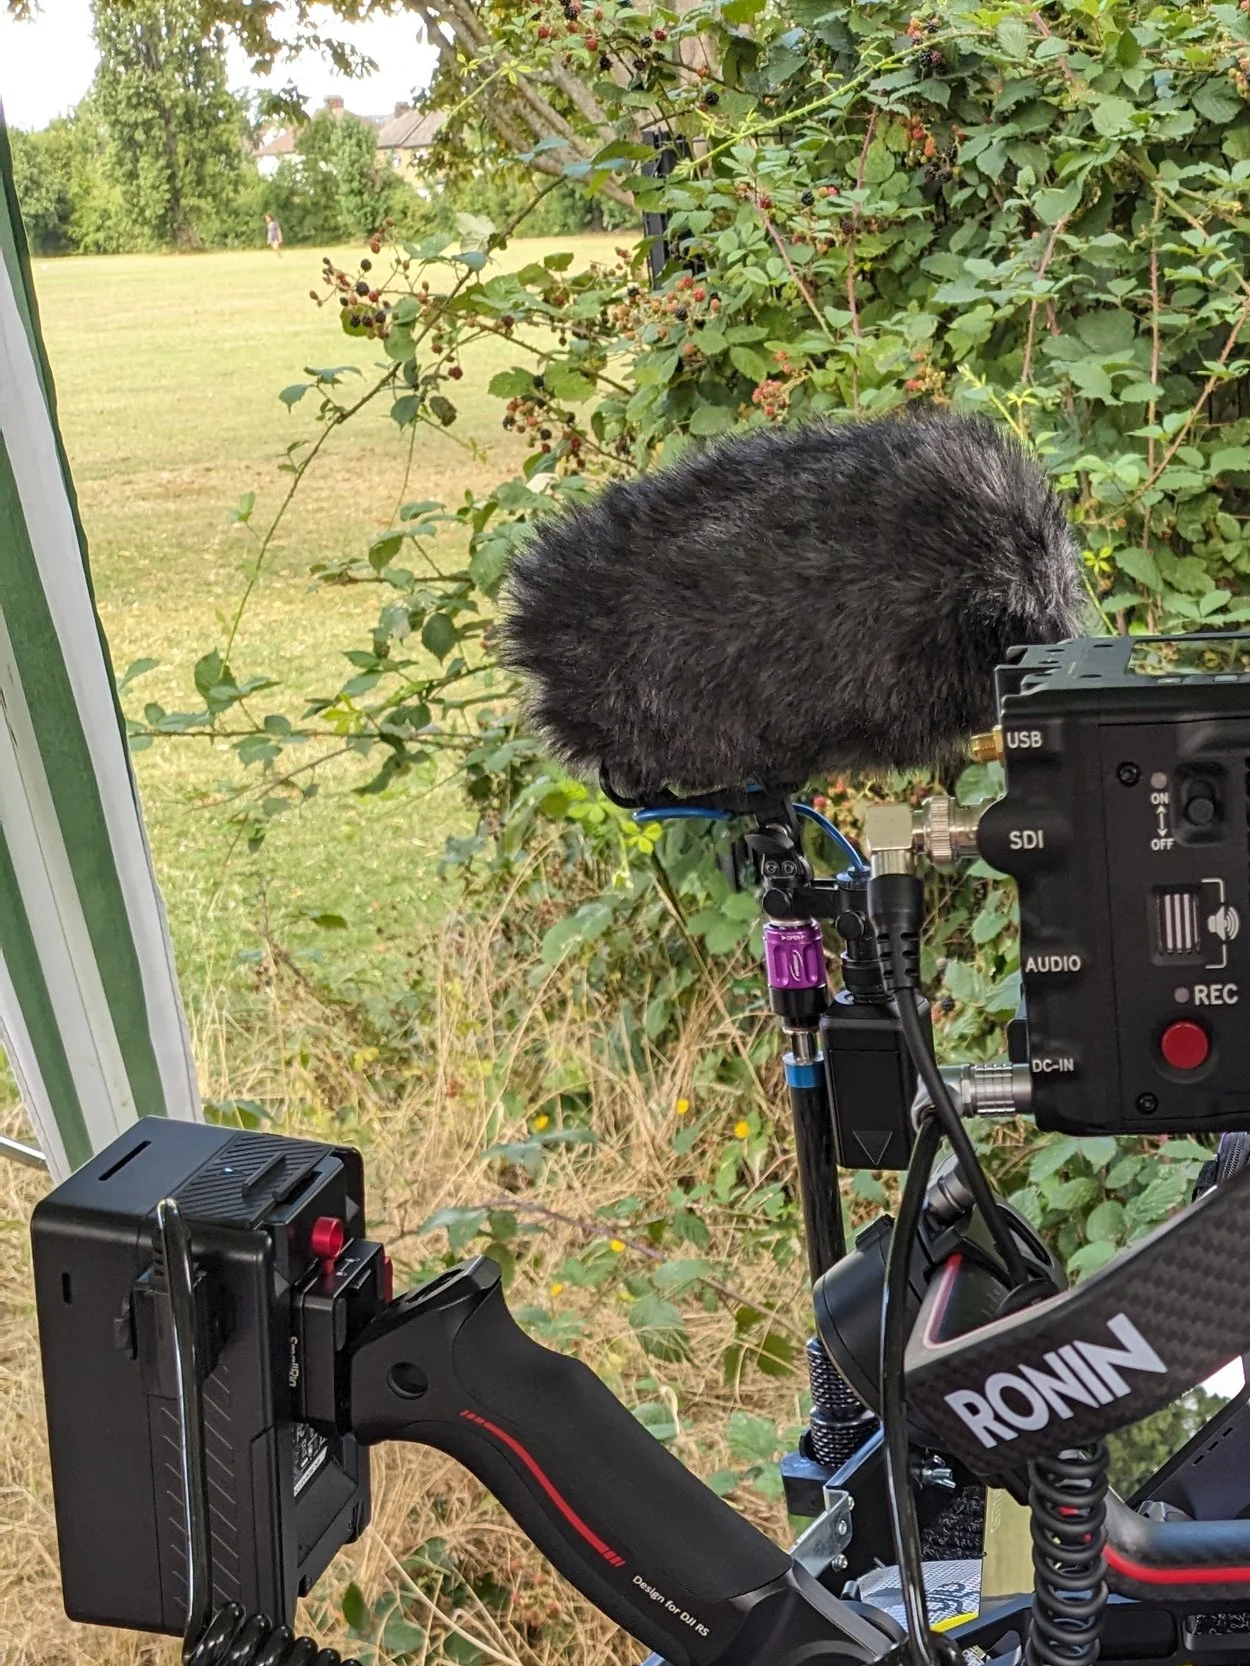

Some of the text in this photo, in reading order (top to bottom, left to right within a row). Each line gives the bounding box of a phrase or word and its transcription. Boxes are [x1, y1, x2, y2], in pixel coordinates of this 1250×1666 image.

[1006, 731, 1043, 749] USB
[1151, 792, 1169, 805] ON
[1009, 829, 1045, 849] SDI
[1151, 838, 1174, 851] OFF
[1025, 955, 1081, 973] AUDIO
[1193, 984, 1239, 1006] REC
[1032, 1058, 1075, 1073] DC-IN
[943, 1312, 1168, 1449] RONIN
[632, 1575, 710, 1637] Design for DJI RS
